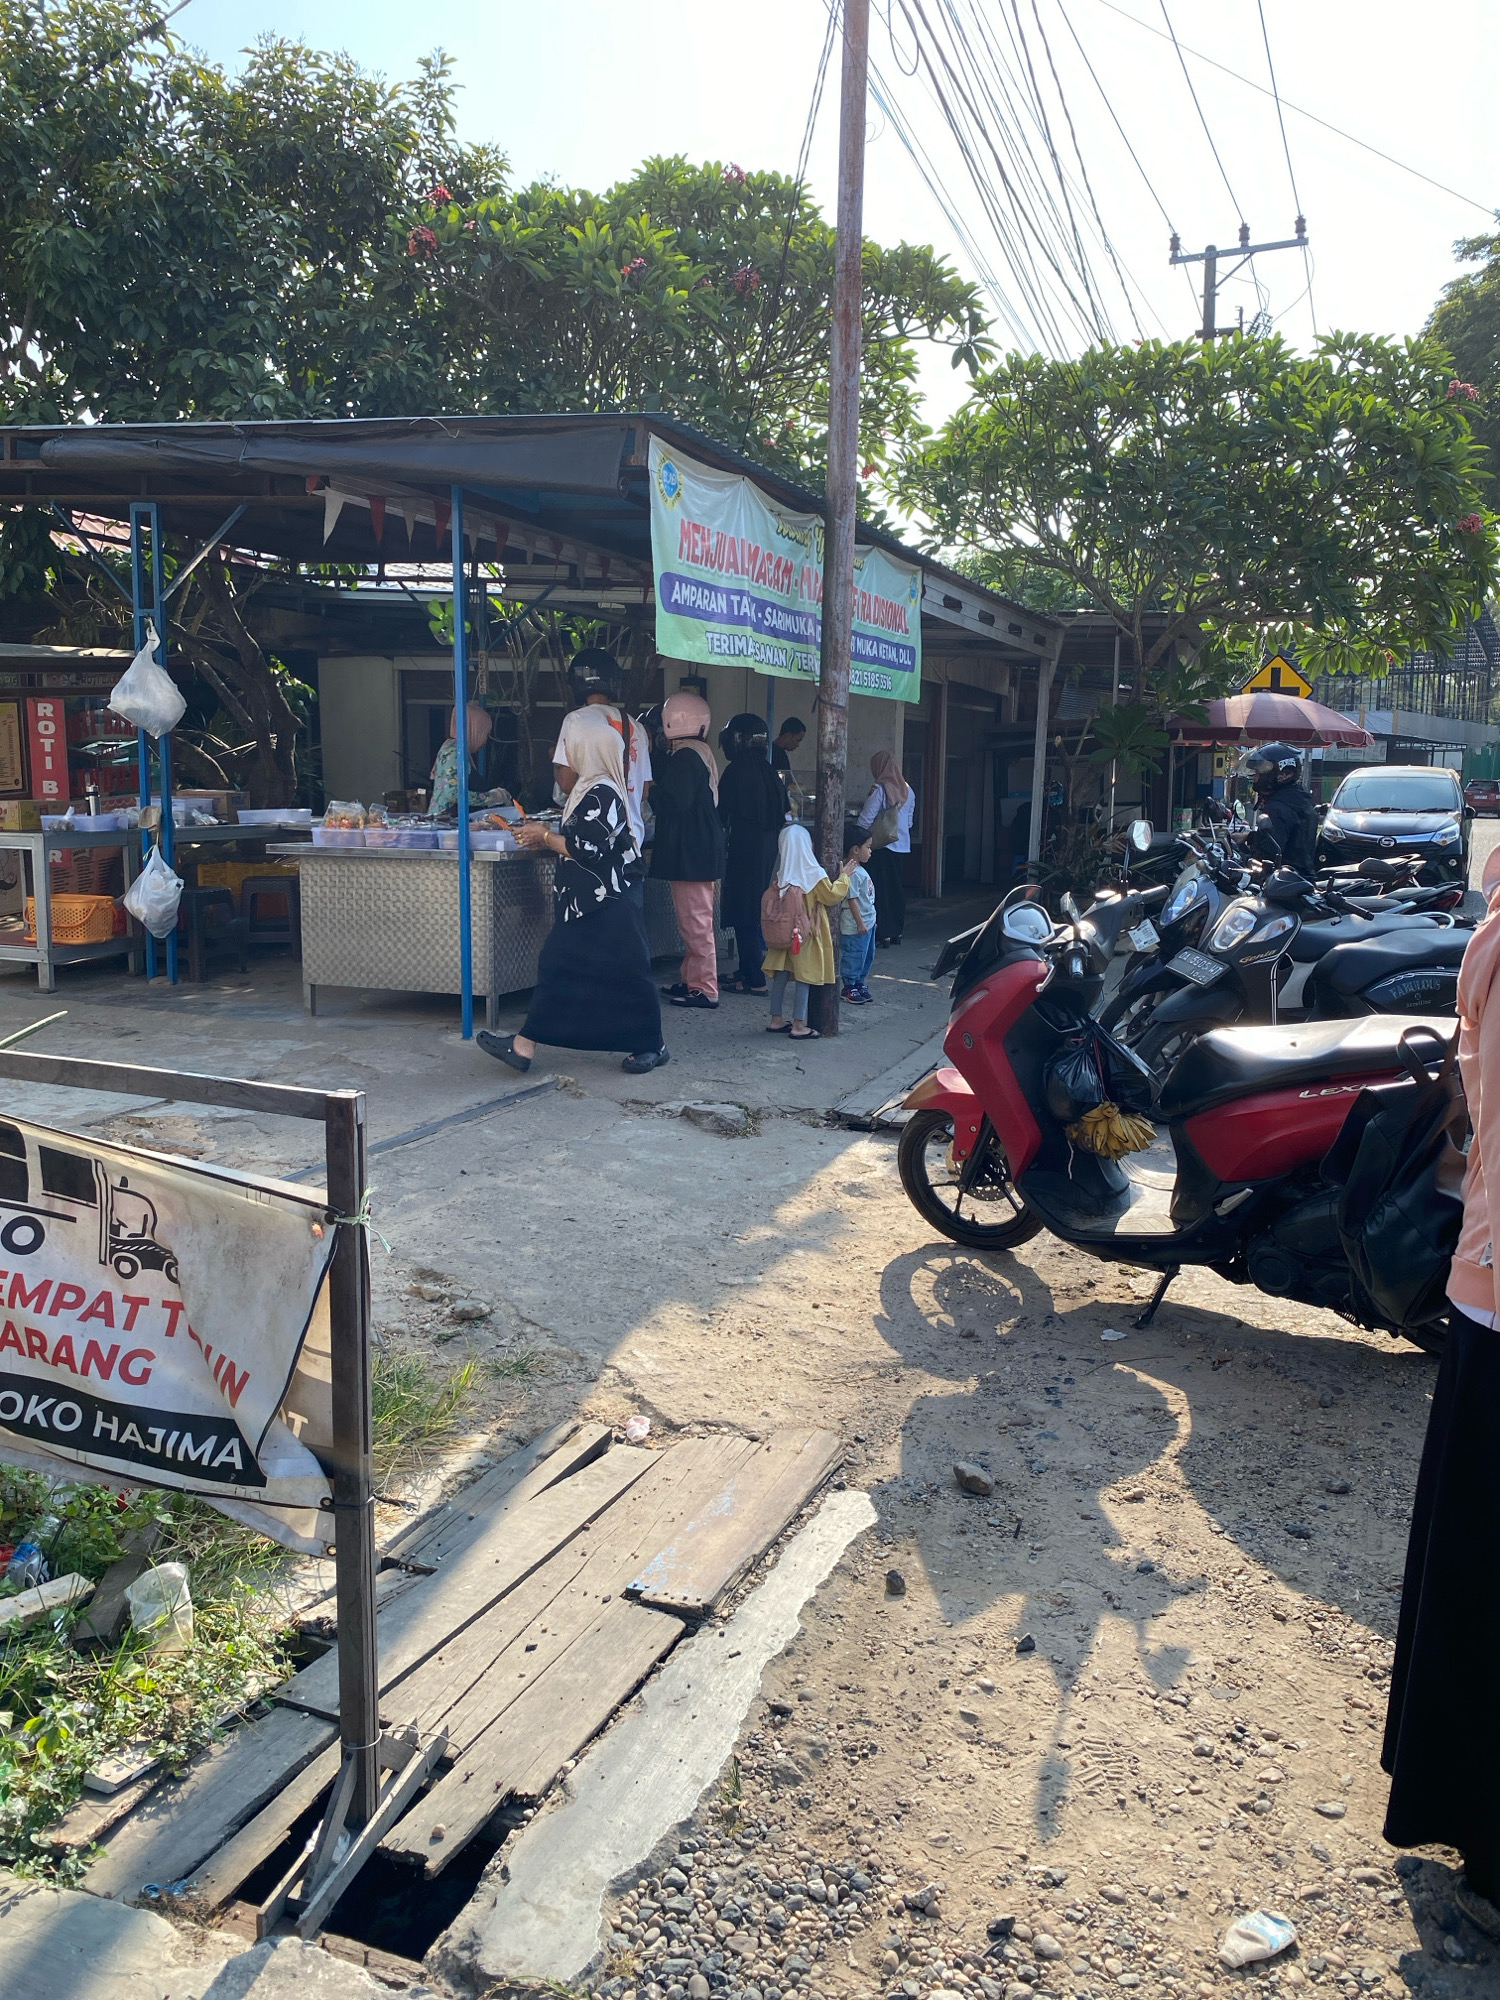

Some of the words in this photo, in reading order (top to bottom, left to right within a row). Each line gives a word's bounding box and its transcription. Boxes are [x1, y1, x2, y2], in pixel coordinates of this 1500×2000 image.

[671, 581, 727, 614] AMPARAN
[856, 637, 878, 658] MUKA
[899, 648, 912, 666] DLL
[864, 671, 880, 688] 5185
[37, 702, 56, 770] ROTI
[1389, 978, 1441, 1000] FABULOUS
[92, 1410, 244, 1470] HAJIMA
